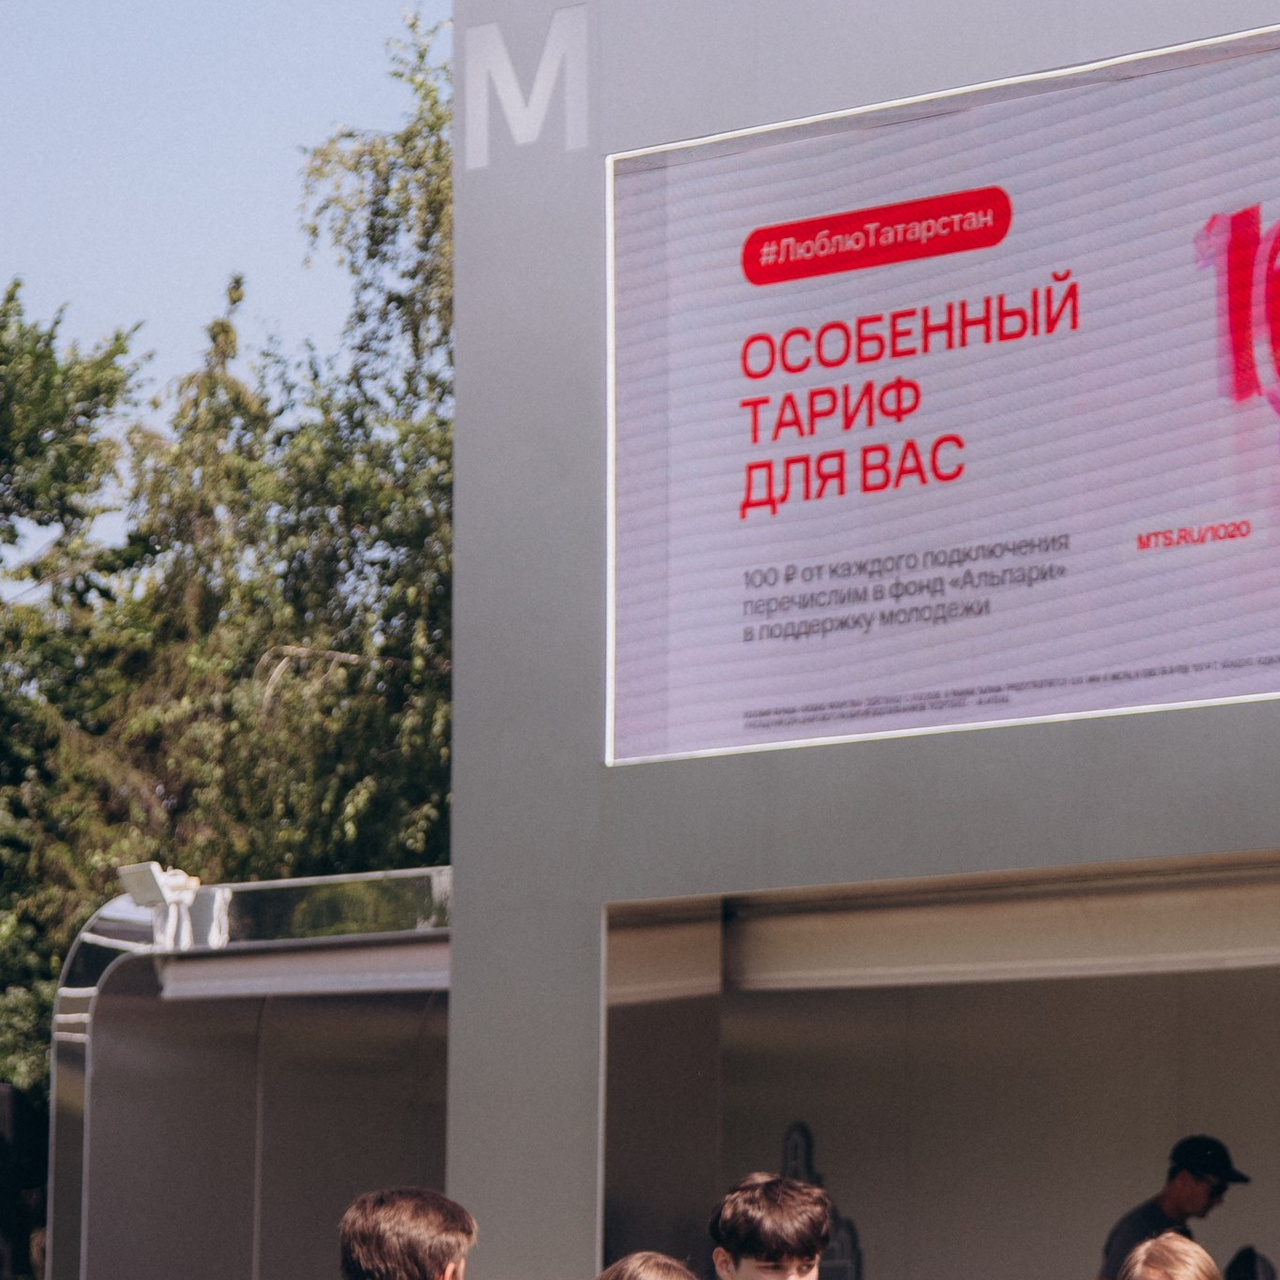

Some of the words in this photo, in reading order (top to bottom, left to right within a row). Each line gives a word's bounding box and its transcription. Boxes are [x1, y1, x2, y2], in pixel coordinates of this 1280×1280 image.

[759, 207, 994, 267] #ЛюблюТатарстан
[740, 269, 1079, 381] ОСОБЕННЫЙ
[740, 376, 922, 445] ТАРИФ
[740, 449, 846, 520] ДЛЯ
[860, 434, 966, 494] ВАС
[743, 567, 778, 590] 100
[801, 564, 824, 583] от
[828, 552, 919, 580] каждого
[922, 533, 1070, 570] подключения
[1137, 520, 1252, 550] MTS.RU/1020
[743, 586, 868, 619] перечислим
[873, 583, 884, 601] в
[888, 575, 945, 604] фонд
[743, 626, 754, 643] в
[759, 611, 875, 640] поддержку
[879, 597, 991, 627] молодежи
